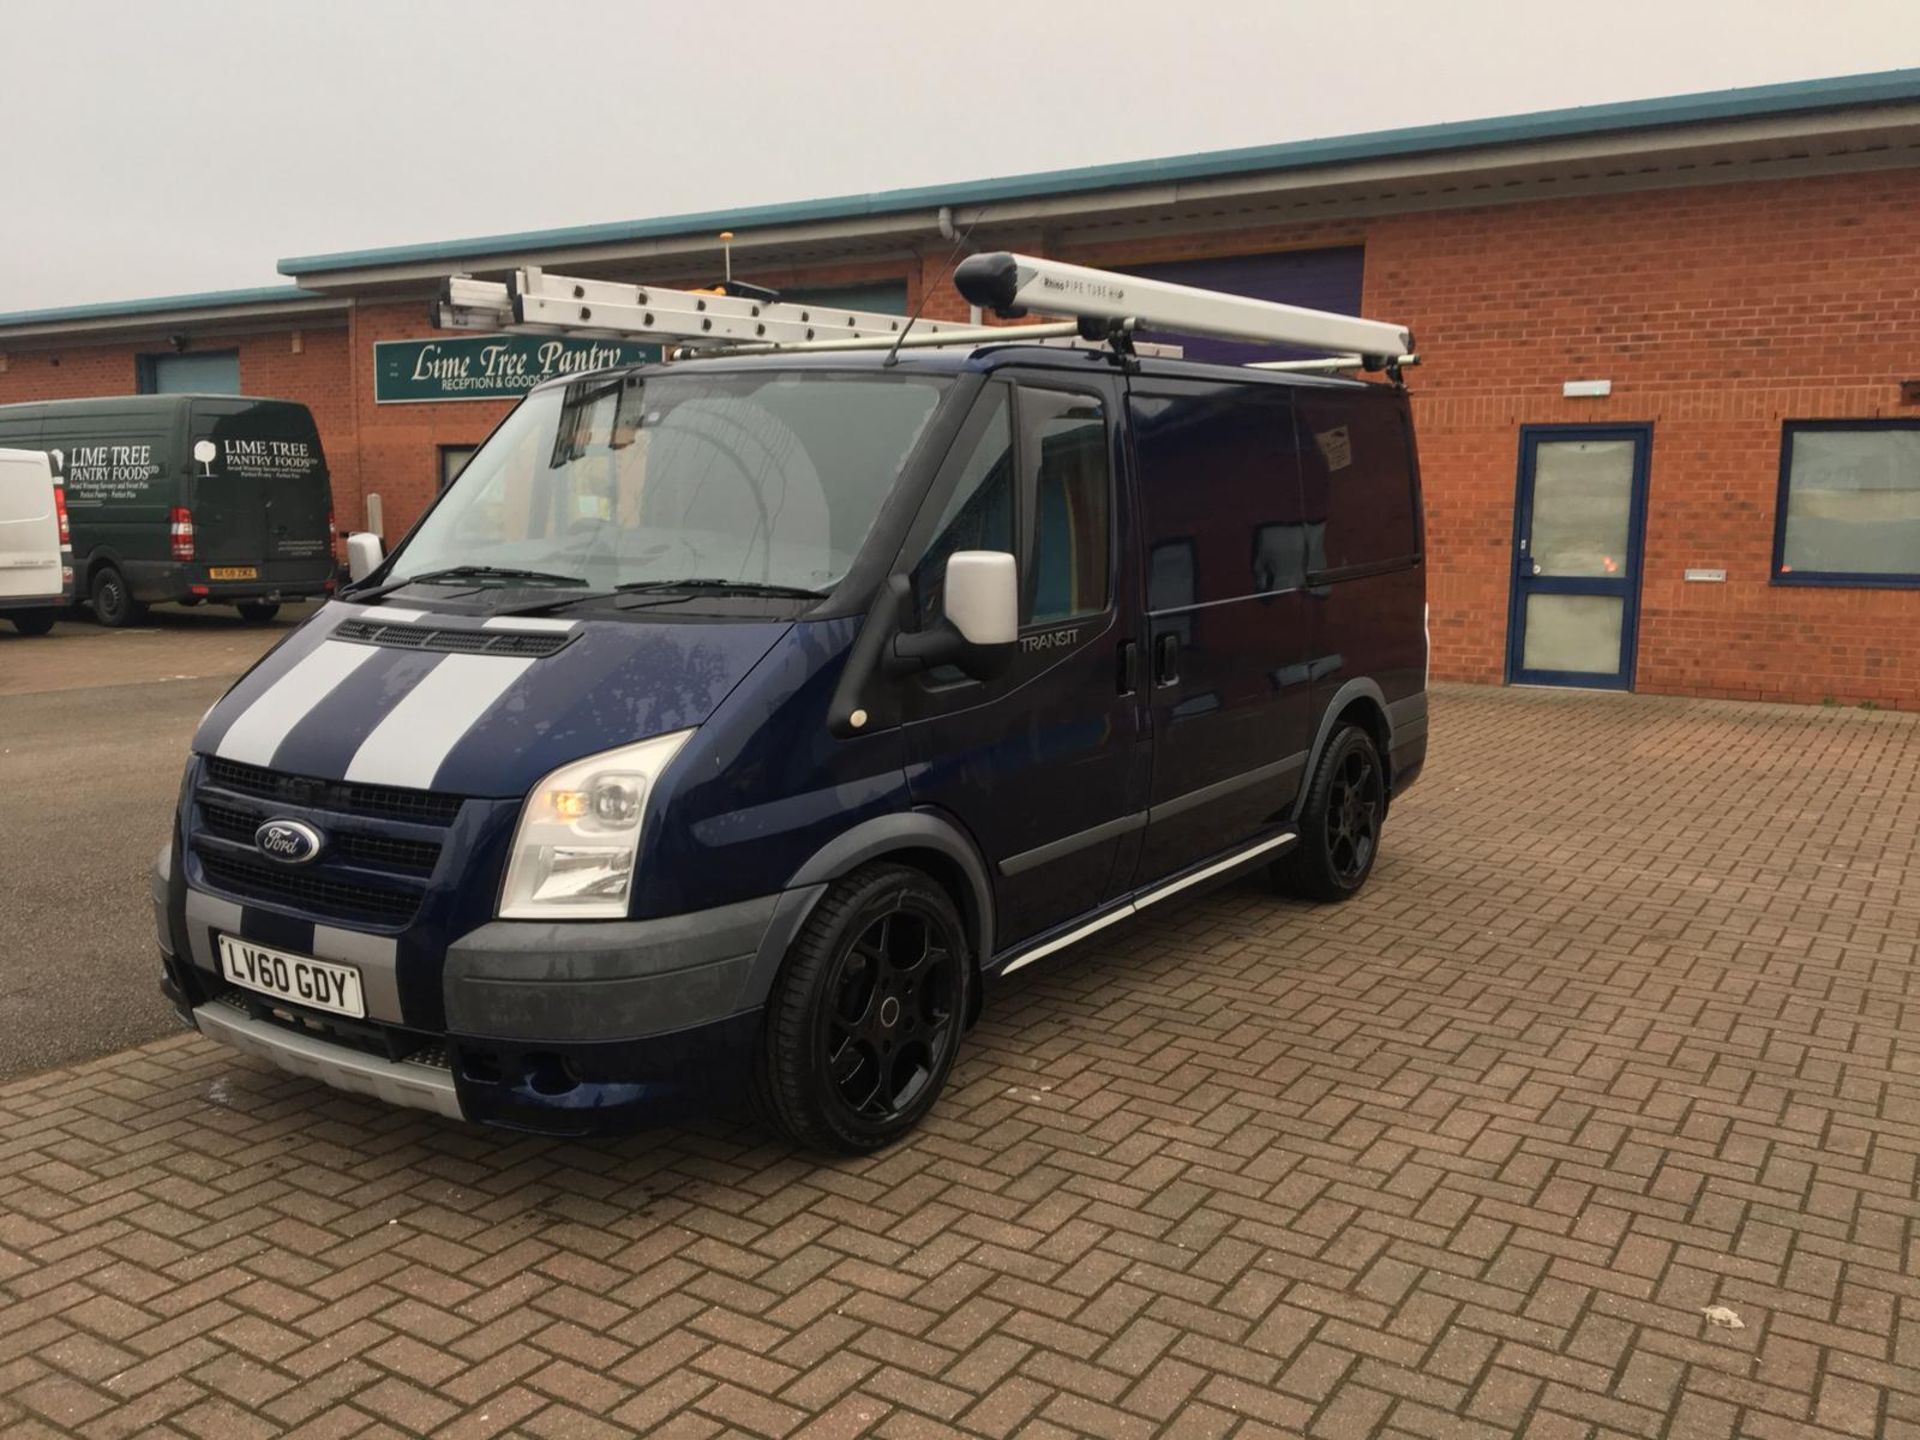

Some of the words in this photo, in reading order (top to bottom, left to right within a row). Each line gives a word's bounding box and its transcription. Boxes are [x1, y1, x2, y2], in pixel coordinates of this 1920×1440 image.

[411, 344, 470, 380] Lime
[480, 345, 528, 376] Tree
[441, 376, 494, 391] RECEPTION
[496, 377, 503, 389] &
[71, 446, 108, 467] LIME
[110, 445, 151, 466] TREE
[224, 439, 267, 455] LIME
[269, 441, 309, 457] TREE
[226, 455, 272, 466] PANTRY
[275, 456, 310, 468] FOODS
[70, 466, 111, 481] PANTRY
[112, 466, 149, 481] FOODS
[1020, 629, 1079, 653] TRANSIT
[264, 827, 298, 854] Ford
[228, 943, 290, 993] LV60
[295, 963, 346, 1007] GDY
